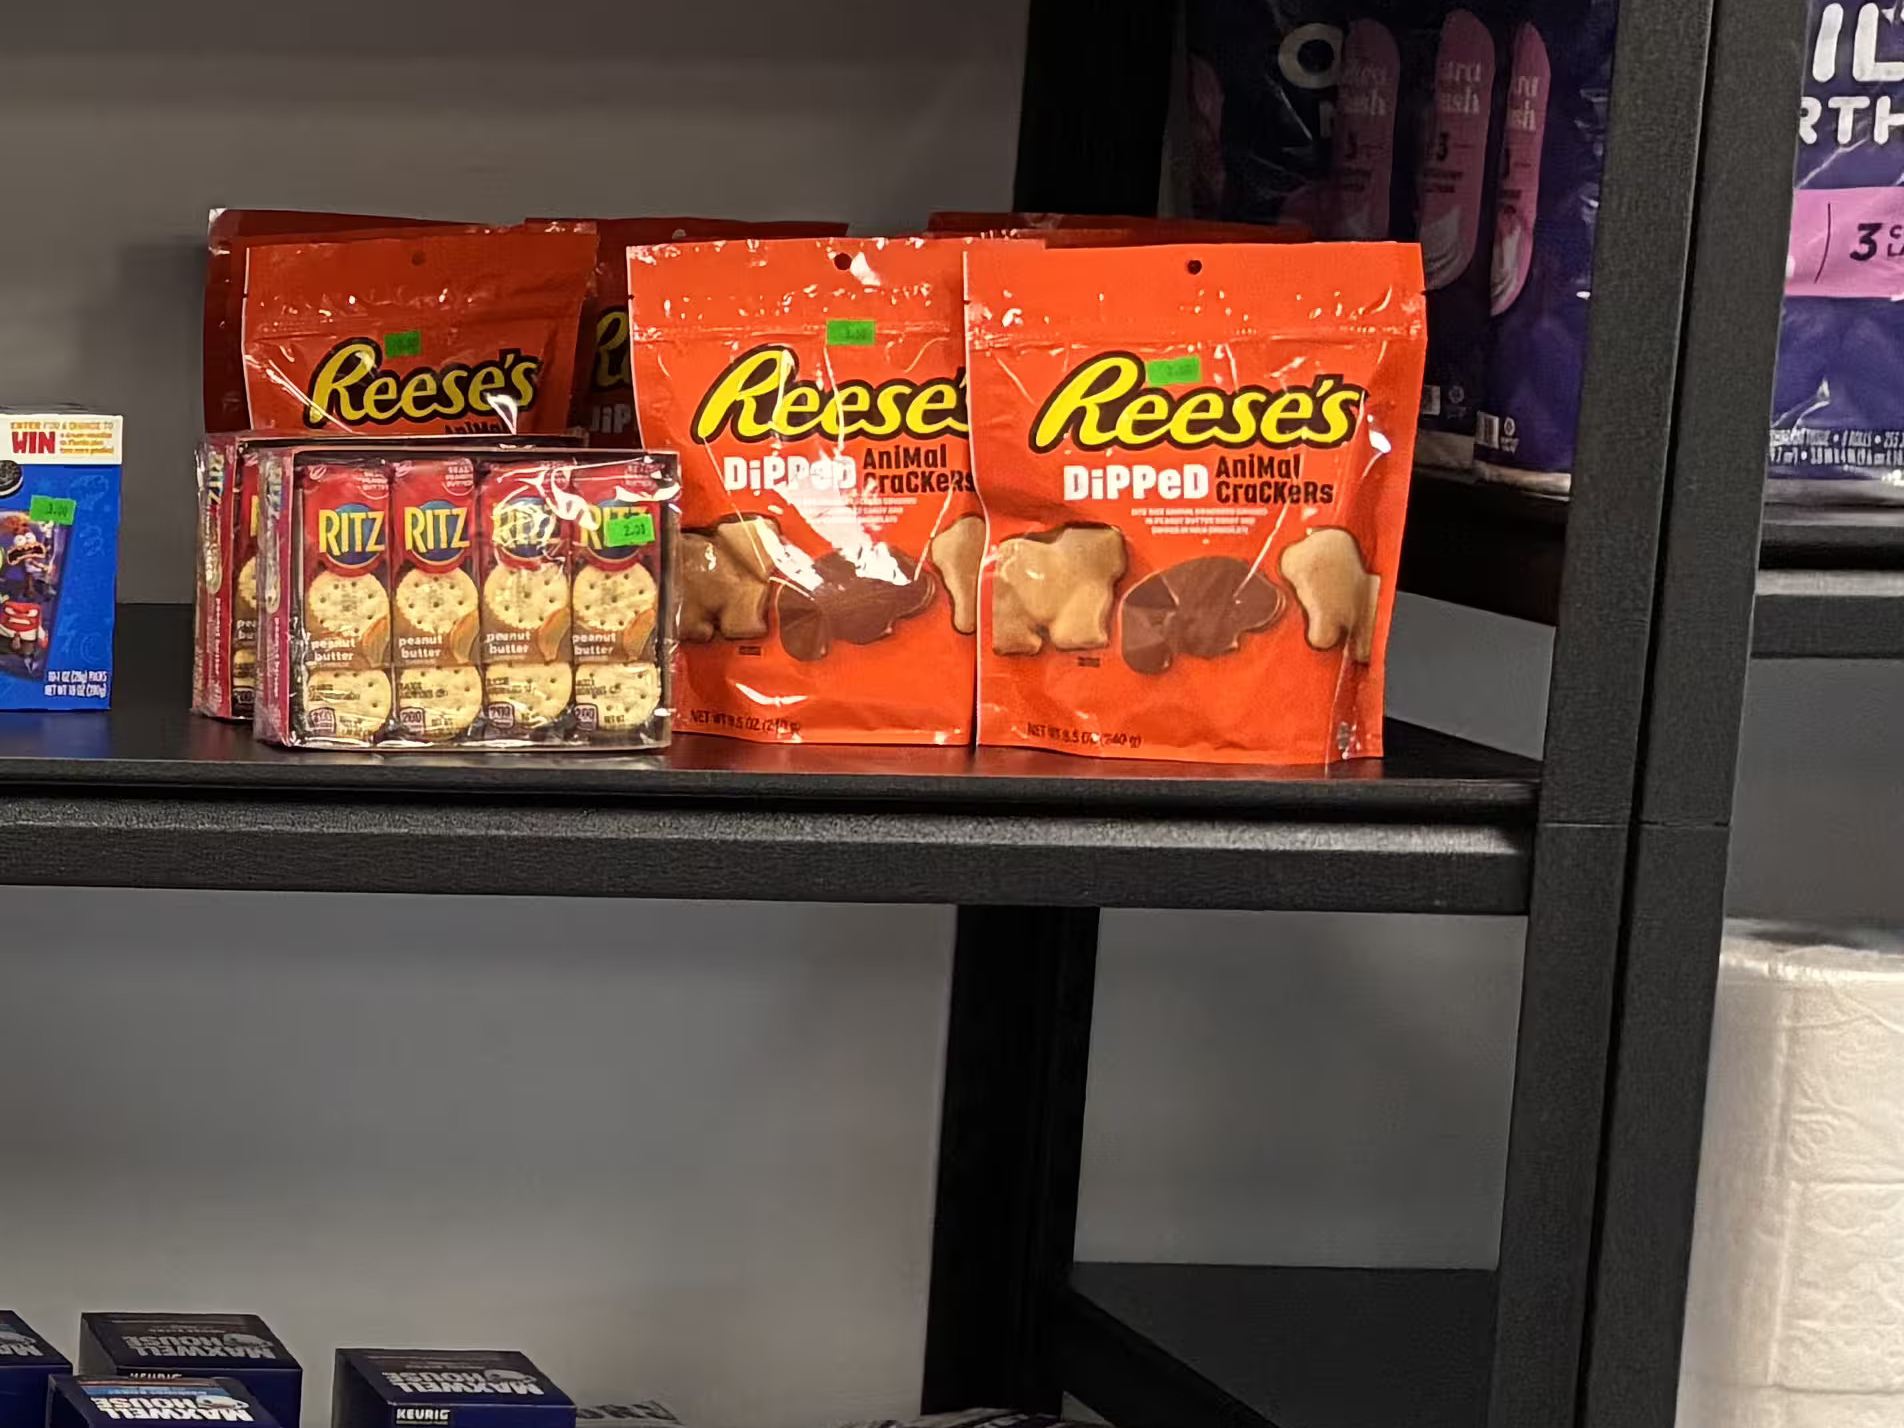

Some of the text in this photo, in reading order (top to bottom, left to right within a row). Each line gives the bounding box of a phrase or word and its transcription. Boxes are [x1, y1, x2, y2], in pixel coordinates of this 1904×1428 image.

[11, 432, 56, 454] WIN
[319, 510, 385, 553] RITZ
[404, 507, 471, 552] RITZ
